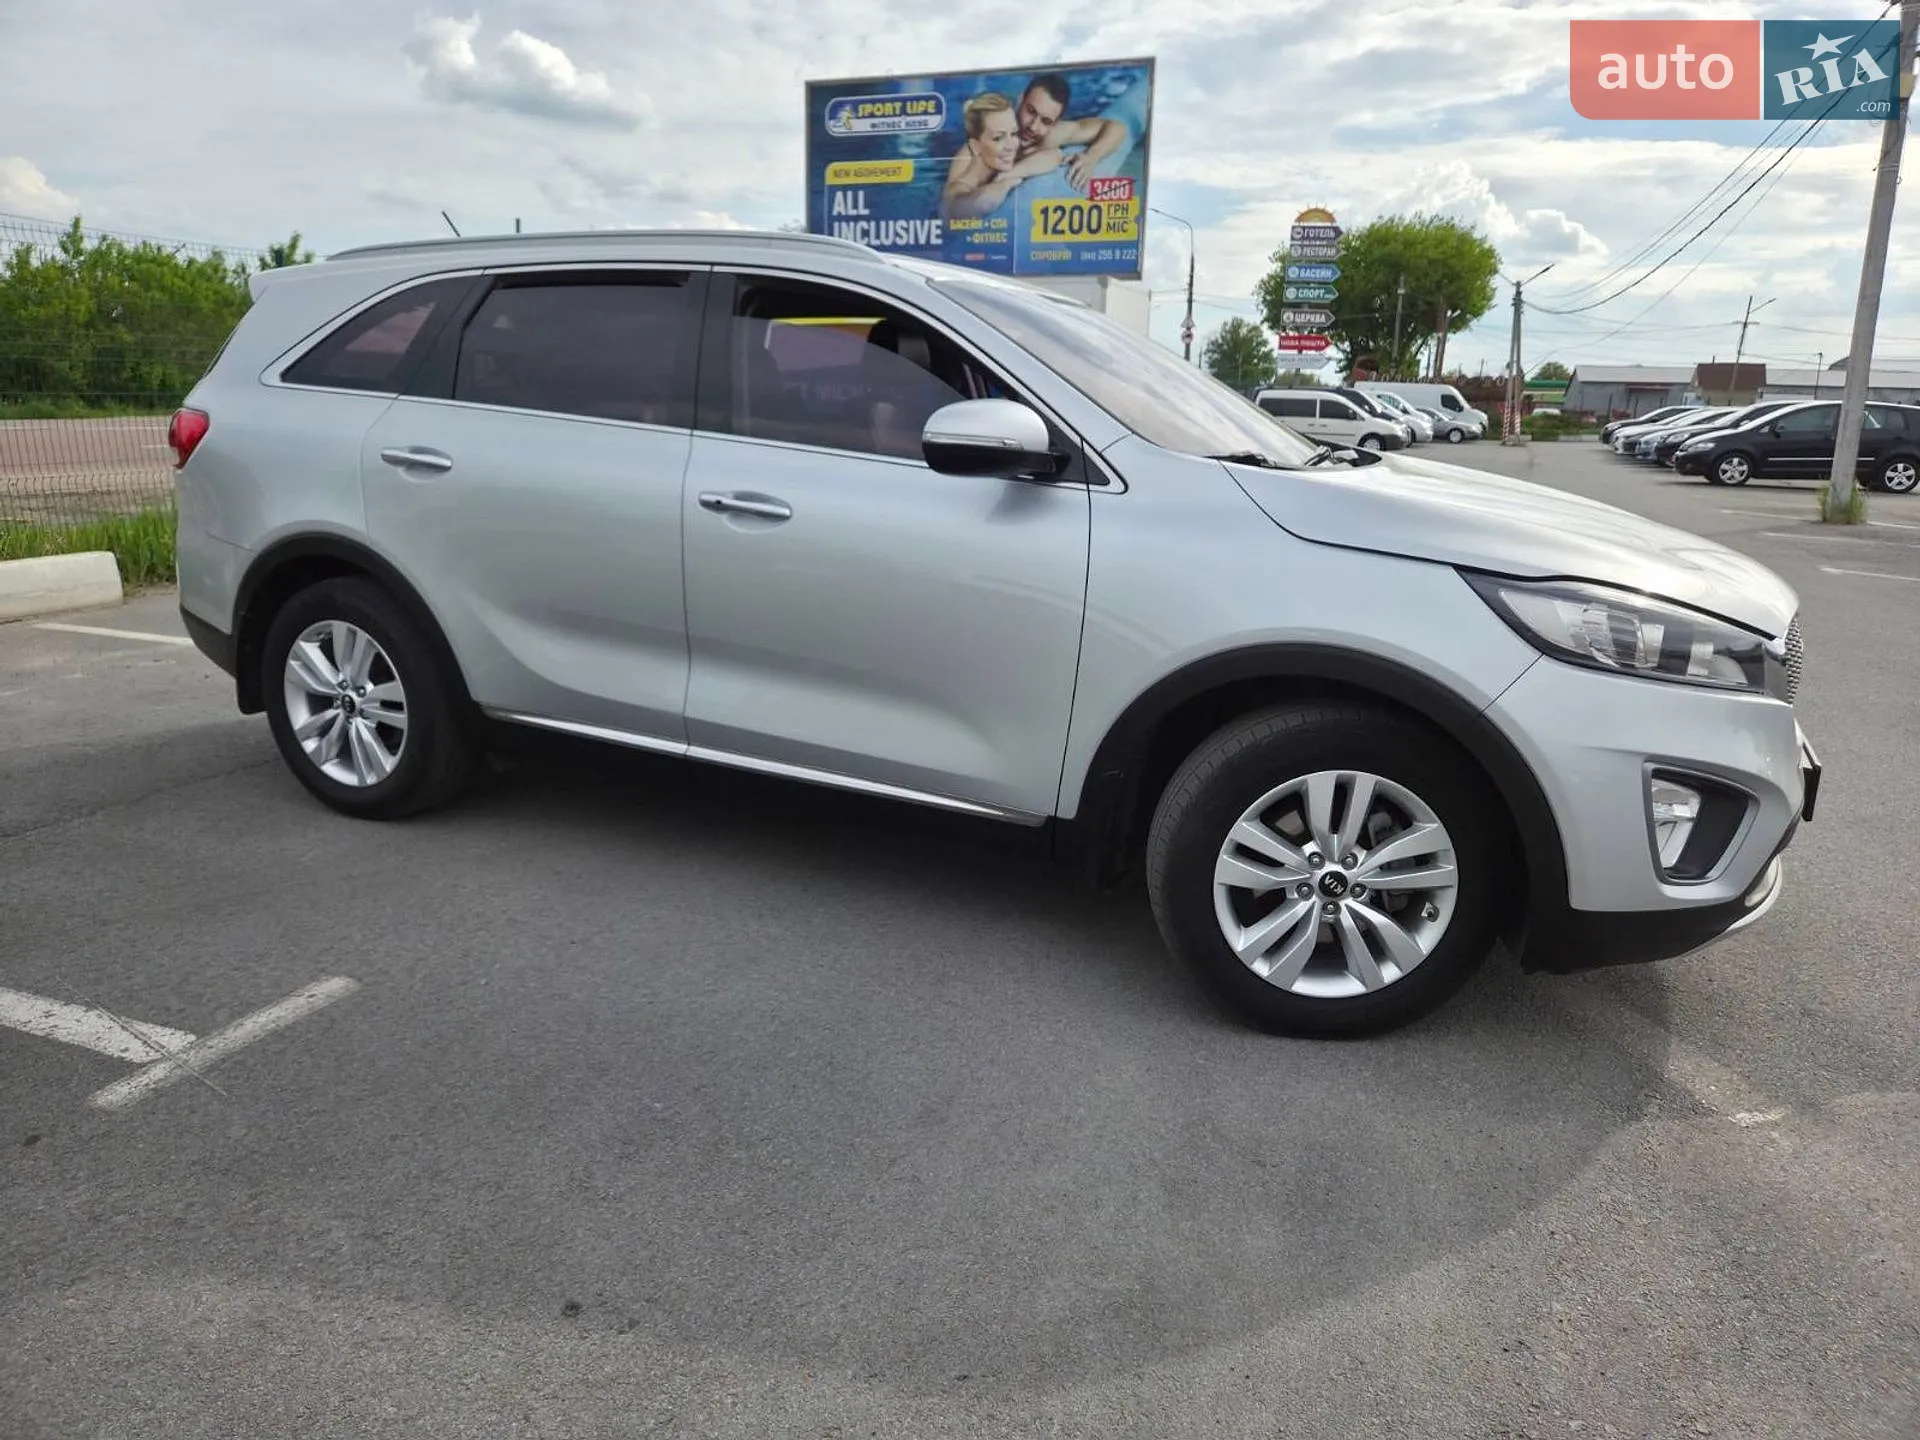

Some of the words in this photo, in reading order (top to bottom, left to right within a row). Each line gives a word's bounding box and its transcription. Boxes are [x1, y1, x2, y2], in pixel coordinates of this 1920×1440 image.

[857, 101, 903, 117] SPORT
[832, 190, 870, 216] ALL
[832, 219, 943, 246] INCLUSIVE
[1040, 203, 1103, 236] 1200
[1107, 203, 1129, 216] ГРН
[1298, 287, 1325, 299] СПОРТ
